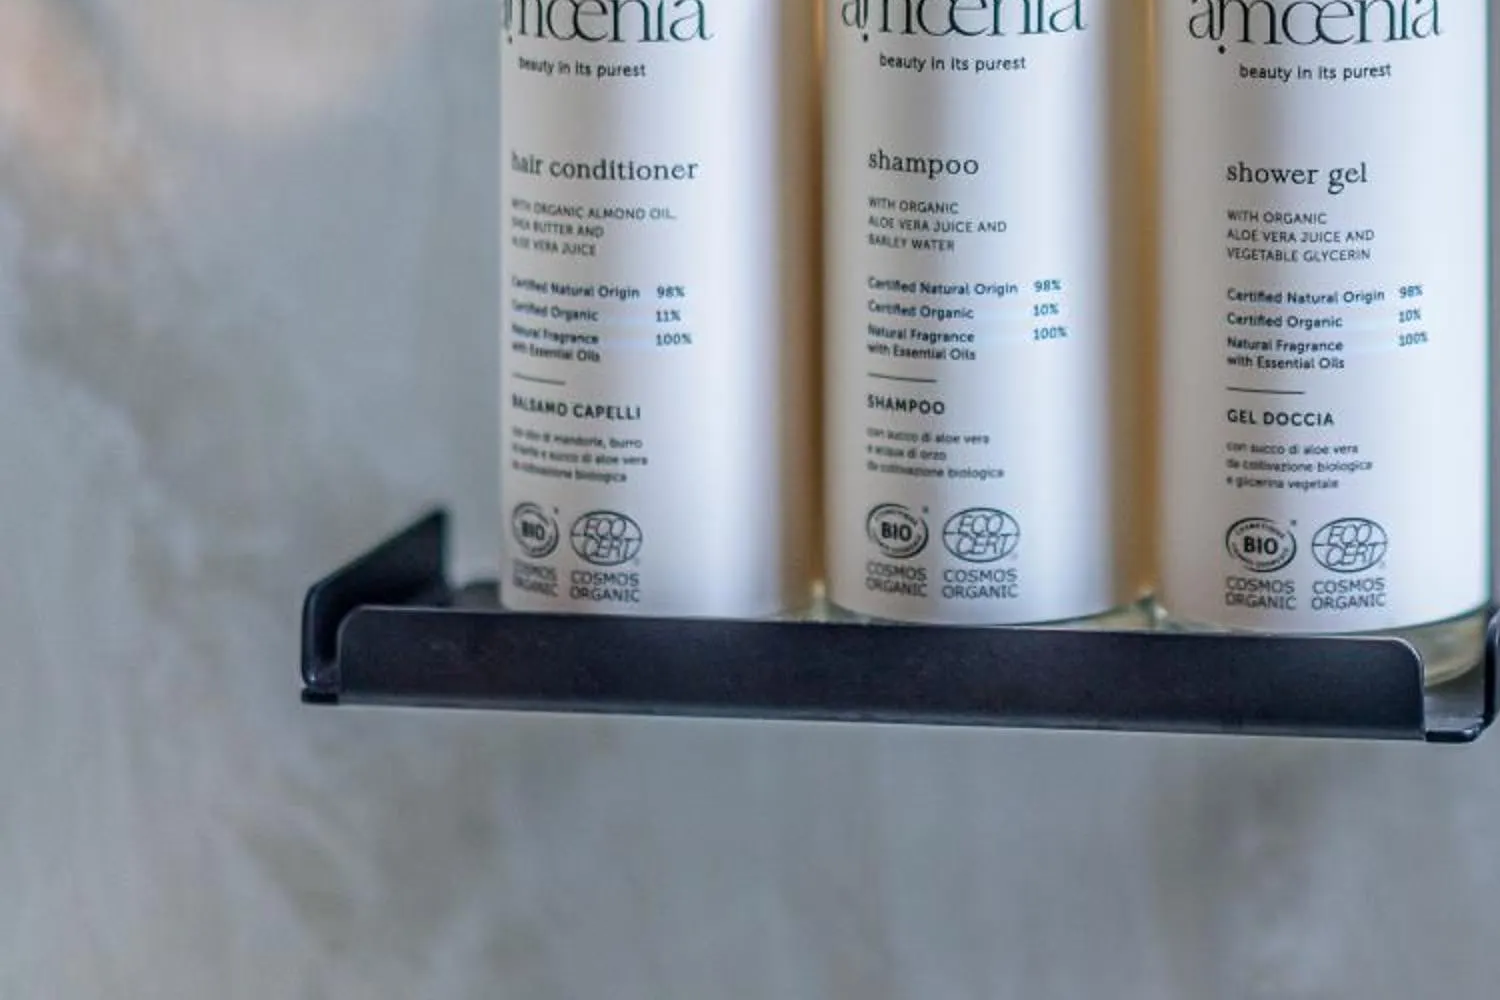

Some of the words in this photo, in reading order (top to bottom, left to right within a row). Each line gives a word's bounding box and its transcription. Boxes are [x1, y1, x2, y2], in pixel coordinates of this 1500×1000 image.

[519, 56, 554, 75] beauty
[558, 60, 570, 73] in
[575, 61, 591, 76] its
[597, 63, 646, 80] purest
[879, 53, 926, 73] beauty
[931, 55, 945, 71] in
[951, 55, 969, 71] its
[975, 56, 1026, 73] purest
[1240, 64, 1292, 82] beauty
[1297, 65, 1312, 80] in
[1318, 65, 1336, 80] its
[1343, 63, 1391, 81] purest
[511, 151, 543, 175] hair
[549, 157, 699, 180] conditioner
[868, 148, 979, 179] shampoo
[1226, 161, 1318, 185] shower
[1328, 161, 1367, 195] gel
[588, 206, 646, 220] ALMOND
[868, 197, 896, 209] WITH
[900, 200, 959, 214] ORGANIC
[868, 216, 894, 229] ALOE
[900, 219, 929, 232] VERA
[933, 221, 973, 233] JUICE
[977, 221, 1007, 233] AND
[1227, 210, 1258, 222] WITH
[1263, 211, 1327, 224] ORGANIC
[577, 224, 604, 238] AND
[1227, 229, 1257, 241] ALOE
[1263, 231, 1296, 243] VERA
[1300, 231, 1340, 243] JUICE
[1345, 229, 1375, 242] AND
[561, 242, 597, 256] JUICE
[868, 234, 907, 249] BARLEY
[911, 239, 955, 251] WATER
[1227, 247, 1299, 262] VEGETABLE
[1303, 249, 1371, 262] GLYCERIN
[551, 282, 594, 297] Natural
[598, 285, 640, 301] Origin
[657, 286, 685, 298] 98%
[868, 276, 916, 294] Certified
[920, 283, 970, 296] Natural
[974, 284, 1018, 298] Origin
[1034, 279, 1061, 293] 98%
[1227, 287, 1282, 304] Certified
[1287, 291, 1338, 305] Natural
[1343, 290, 1385, 304] Origin
[1399, 285, 1423, 299] 98%
[551, 305, 599, 322] Organic
[656, 310, 681, 322] 11%
[868, 300, 916, 318] Certified
[920, 304, 974, 321] Organic
[1033, 303, 1060, 317] 10%
[1227, 312, 1282, 328] Certified
[1287, 315, 1343, 330] Organic
[1399, 308, 1421, 323] 10%
[543, 328, 599, 344] Fragrance
[656, 333, 692, 346] 100%
[868, 324, 907, 340] Natural
[911, 329, 974, 345] Fragrance
[1033, 326, 1068, 341] 100%
[1227, 336, 1272, 350] Natural
[1276, 339, 1344, 354] Fragrance
[1399, 331, 1428, 347] 100%
[577, 349, 600, 362] Oils
[868, 341, 890, 355] with
[893, 344, 946, 360] Essential
[950, 347, 976, 361] Oils
[1226, 355, 1253, 367] with
[1257, 356, 1315, 369] Essential
[1319, 357, 1345, 369] Oils
[512, 394, 568, 416] BALSAMO
[573, 404, 641, 420] CAPELLI
[867, 394, 945, 415] SHAMPOO
[1227, 409, 1257, 425] GEL
[1263, 411, 1334, 427] DOCCIA
[1250, 443, 1285, 455] succo
[1303, 443, 1329, 455] aloe
[1333, 445, 1359, 454] vera
[1317, 460, 1373, 474] biologica
[1288, 479, 1339, 492] vegetale
[881, 521, 912, 541] BIO
[958, 514, 1004, 535] ECO
[1328, 524, 1373, 546] ECO
[1243, 536, 1278, 555] BIO
[571, 570, 640, 587] COSMOS
[866, 561, 926, 581] COSMOS
[944, 568, 1017, 583] COSMOS
[569, 586, 640, 603] ORGANIC
[865, 577, 928, 597] ORGANIC
[942, 584, 1019, 599] ORGANIC
[1227, 577, 1295, 594] COSMOS
[1312, 578, 1385, 594] COSMOS
[1225, 592, 1297, 610] ORGANIC
[1311, 593, 1386, 610] ORGANIC
